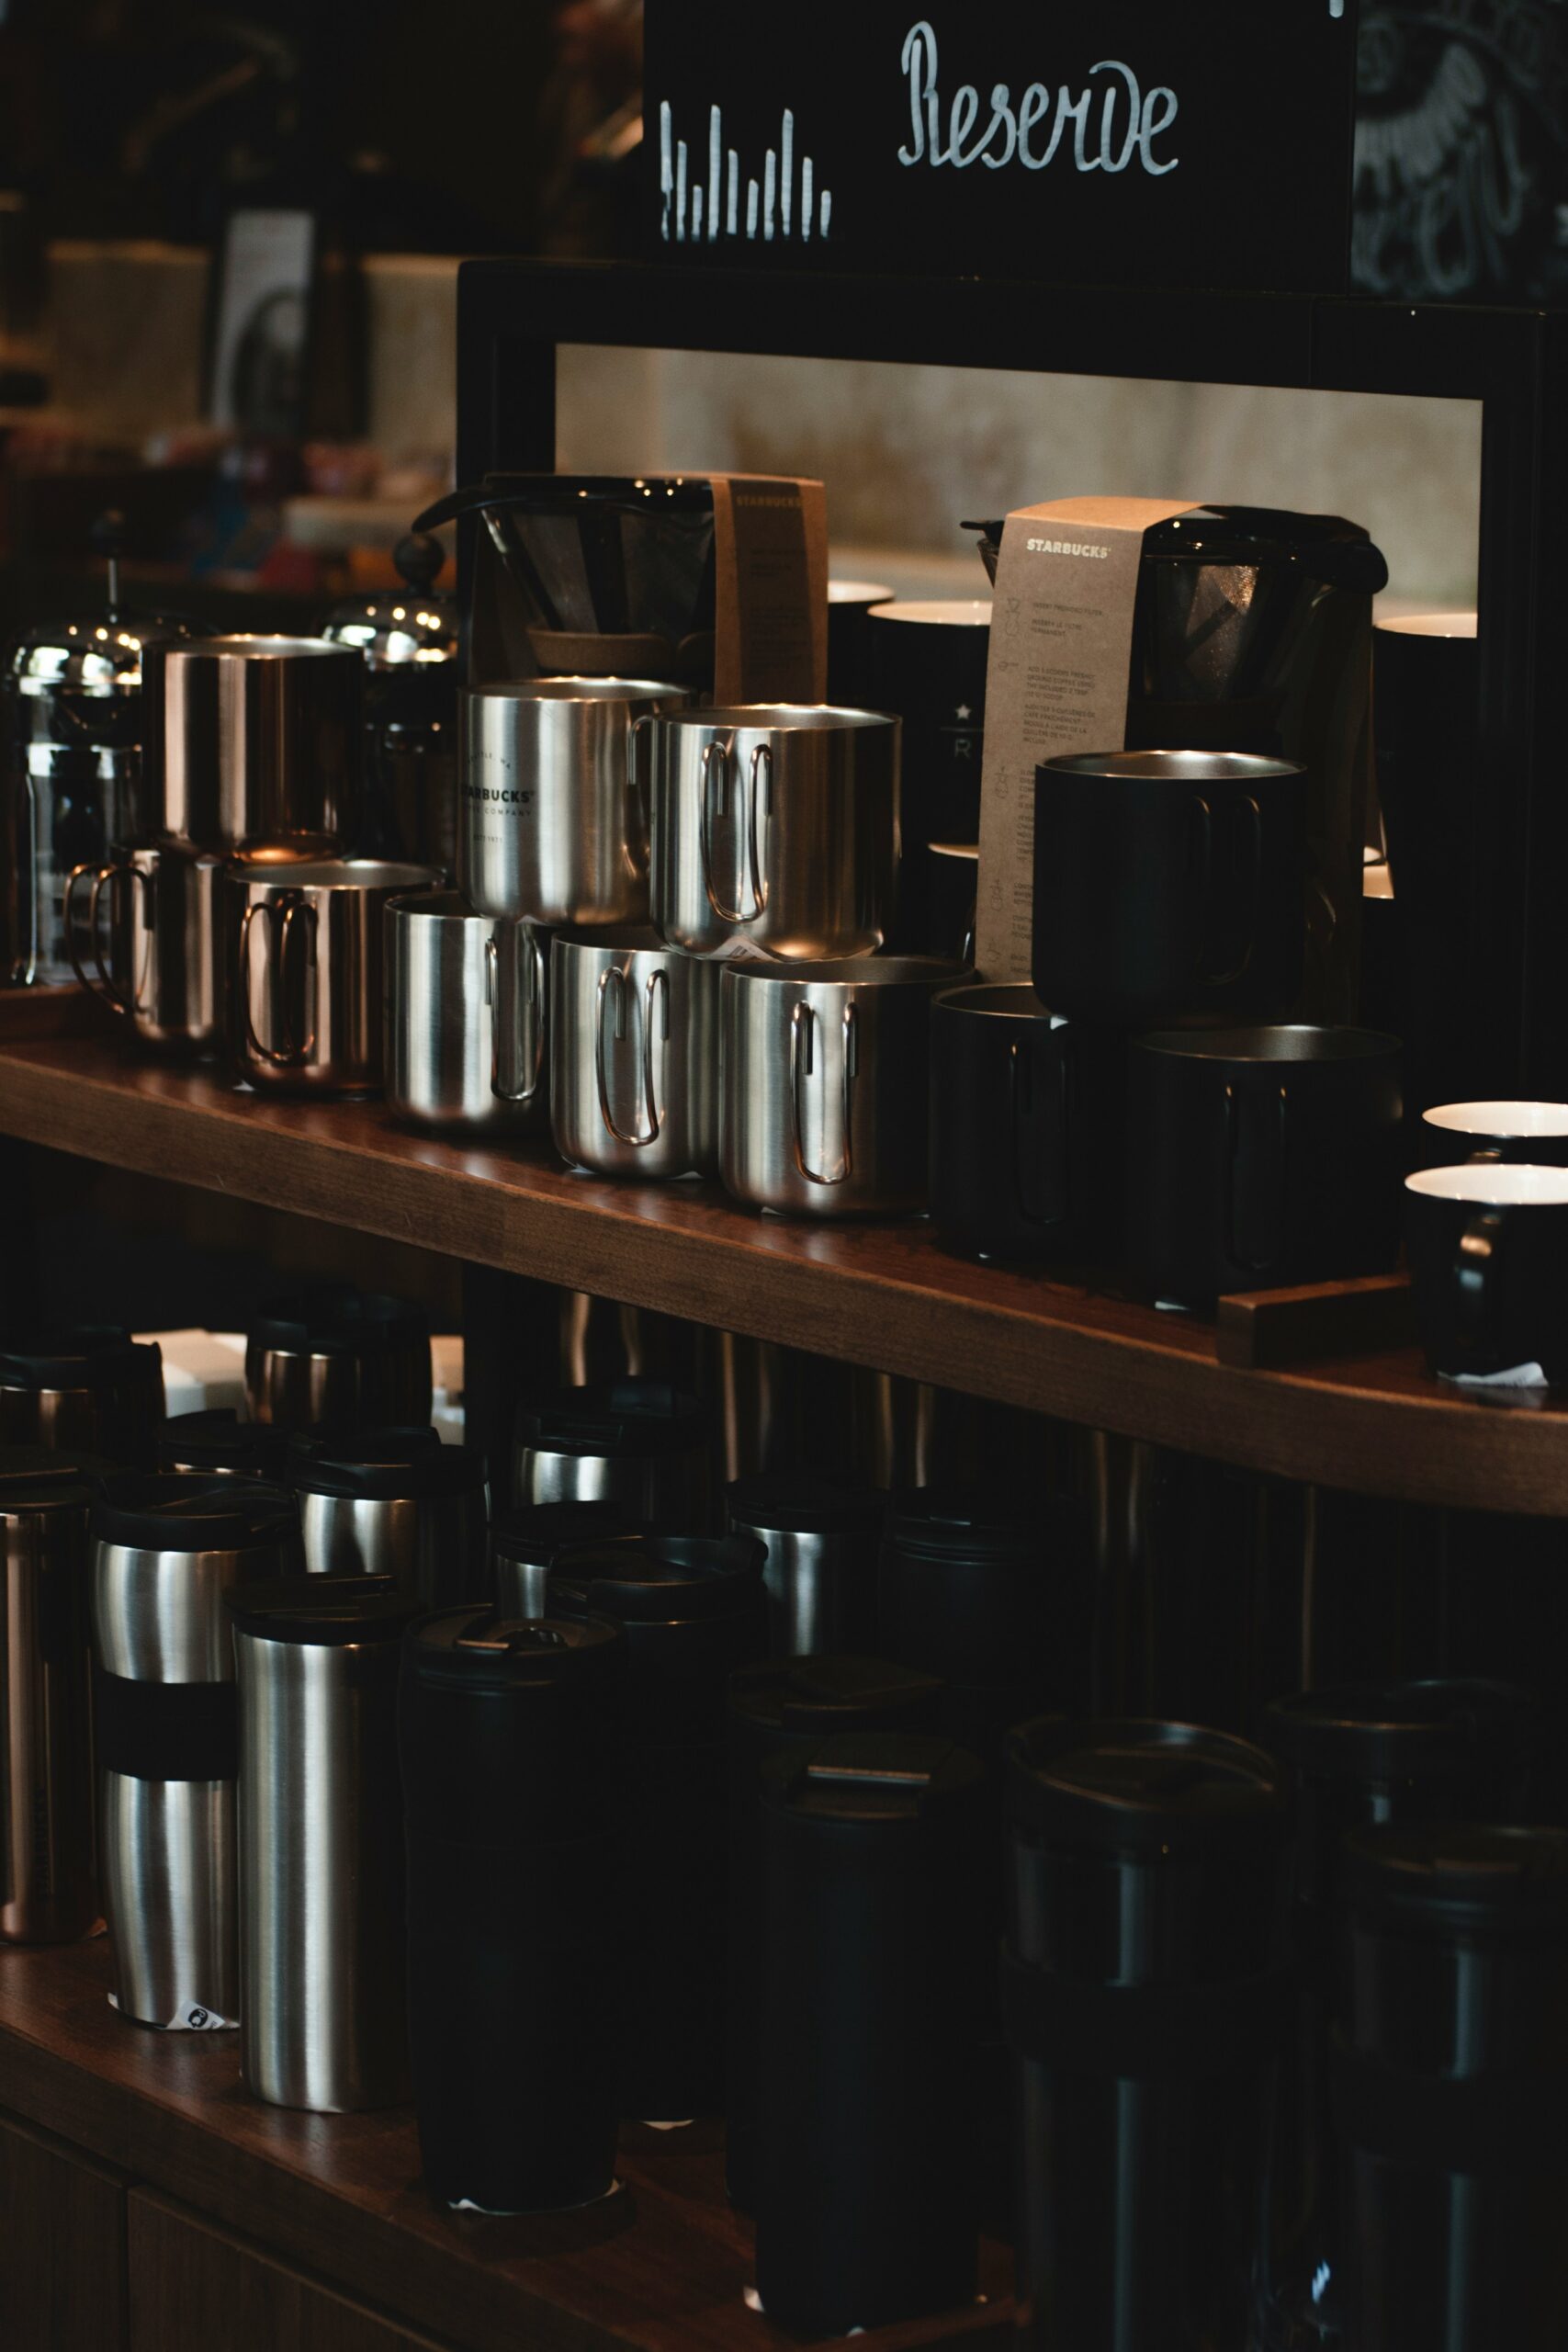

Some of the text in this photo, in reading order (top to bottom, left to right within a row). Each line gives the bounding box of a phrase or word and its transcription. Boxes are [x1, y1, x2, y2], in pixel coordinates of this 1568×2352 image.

[897, 20, 1179, 175] Reserve
[1027, 538, 1109, 559] STARBUCKS
[953, 738, 972, 759] R
[485, 807, 532, 817] COMPANY
